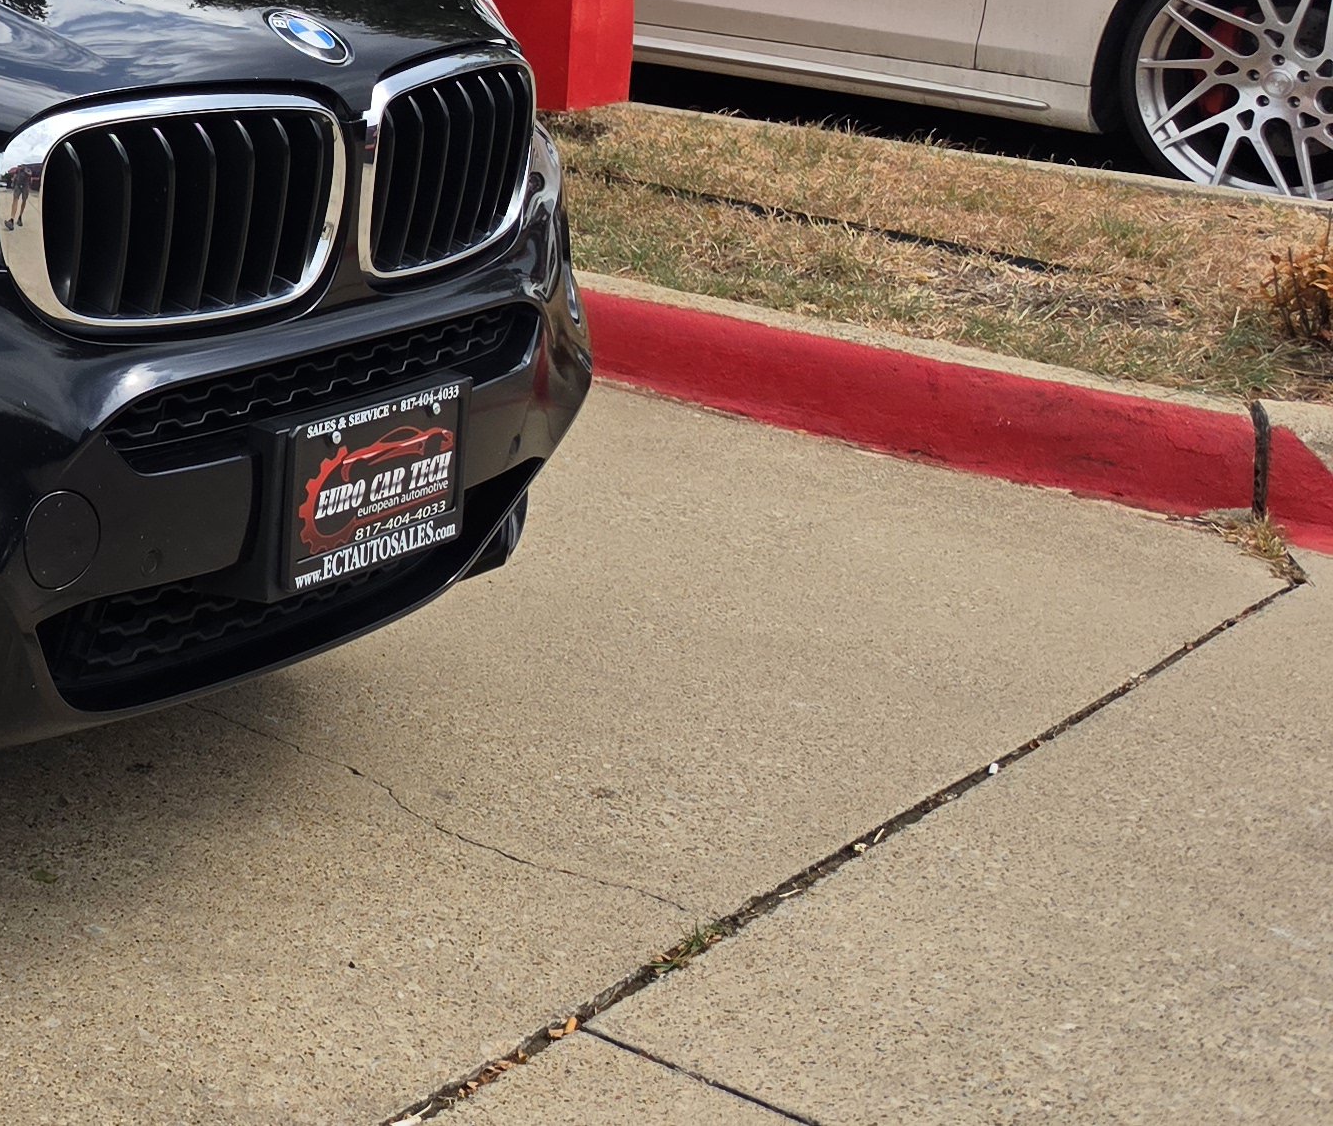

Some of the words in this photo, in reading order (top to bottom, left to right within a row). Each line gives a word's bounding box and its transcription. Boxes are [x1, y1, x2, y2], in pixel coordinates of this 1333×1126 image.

[307, 420, 336, 439] SALES
[337, 416, 347, 429] &
[348, 404, 390, 426] SERVICE
[400, 385, 460, 412] 817-404-4033
[314, 479, 366, 520] EURO
[369, 466, 406, 502] CAR
[408, 451, 453, 490] TECH
[357, 498, 400, 517] european
[400, 479, 449, 504] automotive
[354, 500, 446, 541] 817-404-4033
[294, 520, 456, 589] www.ECTAUTOSALES.com
